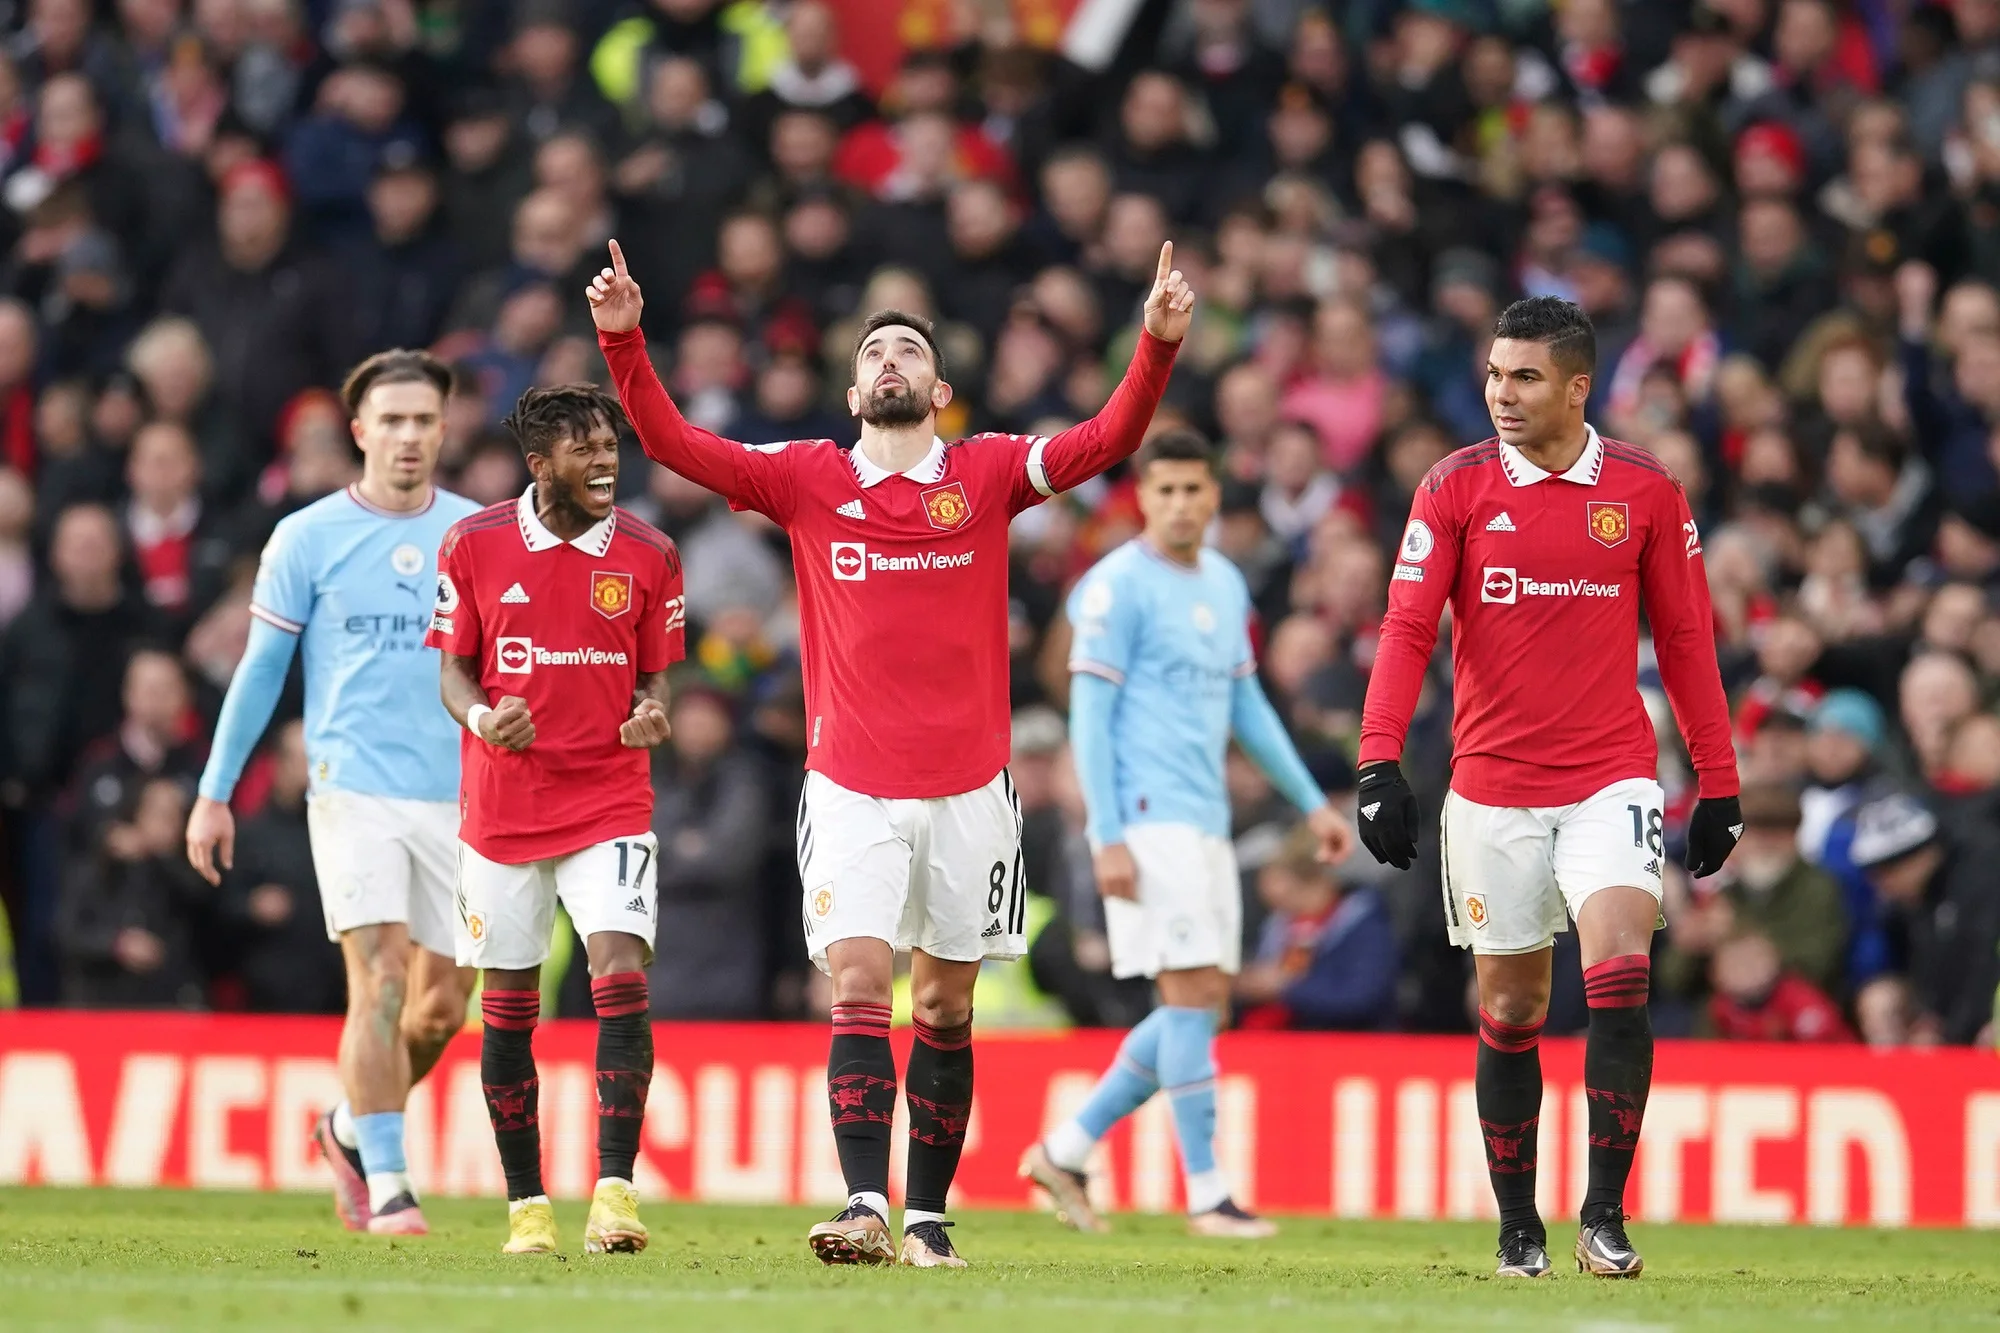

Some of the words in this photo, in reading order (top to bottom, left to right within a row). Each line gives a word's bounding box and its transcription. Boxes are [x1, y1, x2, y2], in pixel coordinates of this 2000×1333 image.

[836, 507, 866, 520] adidas
[1486, 524, 1516, 532] adidas
[867, 550, 975, 571] TeamViewer
[1519, 578, 1620, 597] TeamViewer
[1627, 804, 1663, 858] 18
[614, 842, 651, 889] 17
[987, 860, 1006, 914] 8
